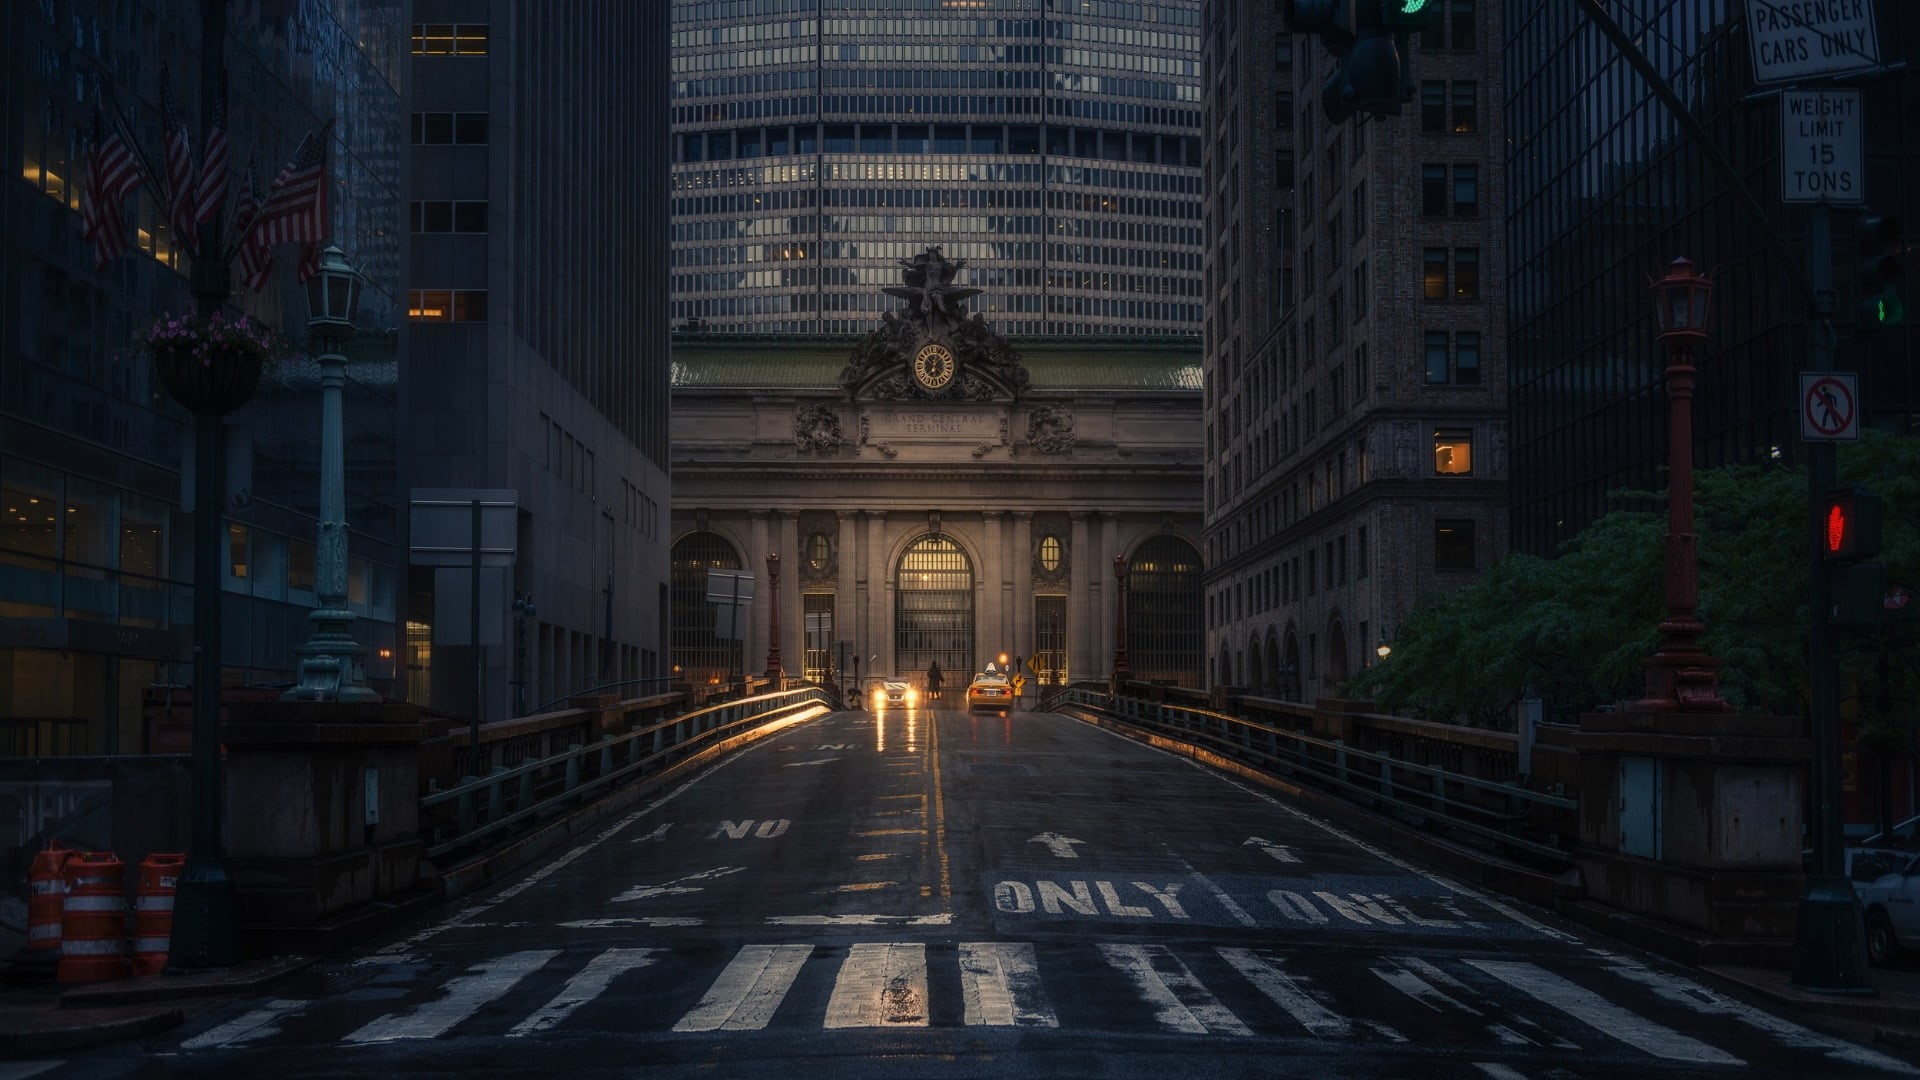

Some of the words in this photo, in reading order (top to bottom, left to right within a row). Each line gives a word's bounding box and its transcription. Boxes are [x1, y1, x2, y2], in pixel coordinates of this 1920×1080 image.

[1756, 0, 1864, 32] PASSENGER
[1760, 37, 1808, 65] CARS
[1821, 28, 1865, 58] ONLY
[1790, 99, 1854, 116] WEIGHT
[1800, 121, 1844, 137] LIMIT
[1809, 145, 1835, 164] 15
[1794, 172, 1852, 192] TONS
[885, 414, 925, 424] GRAND
[931, 414, 984, 424] CENTRAL
[906, 424, 963, 433] TERMINAL
[993, 879, 1191, 920] ONLY
